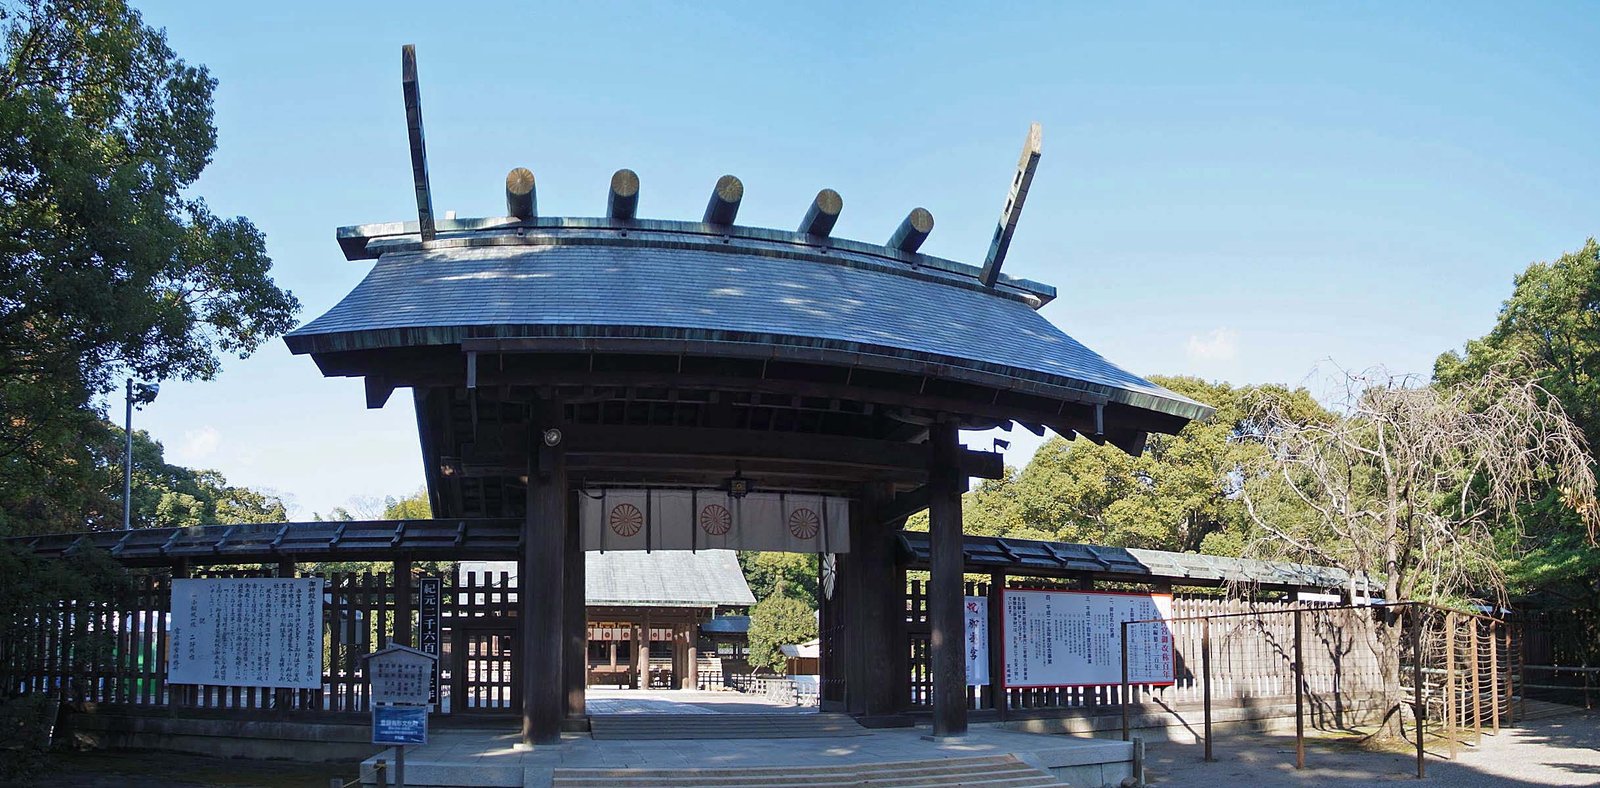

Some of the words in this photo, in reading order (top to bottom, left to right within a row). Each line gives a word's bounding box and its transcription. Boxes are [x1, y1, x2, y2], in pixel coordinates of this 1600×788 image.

[424, 583, 436, 699] 紀元二千六百年
